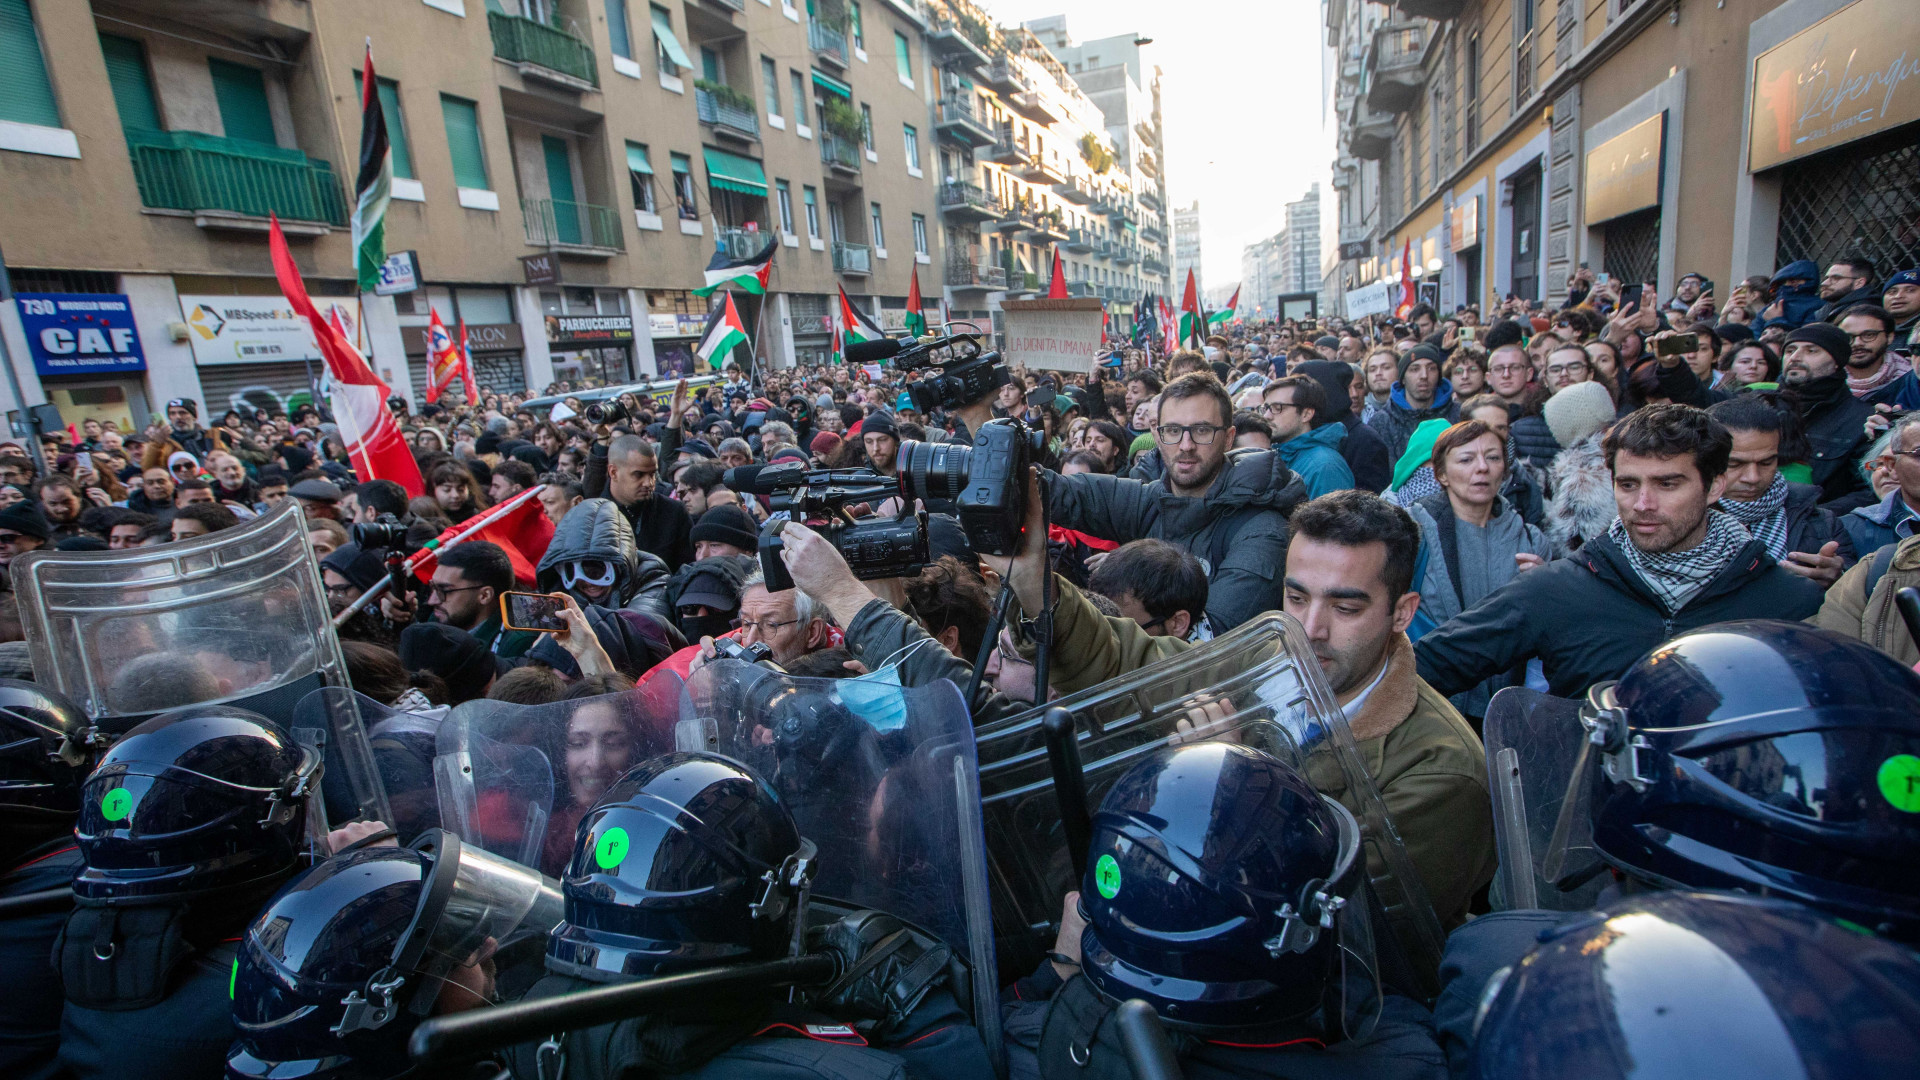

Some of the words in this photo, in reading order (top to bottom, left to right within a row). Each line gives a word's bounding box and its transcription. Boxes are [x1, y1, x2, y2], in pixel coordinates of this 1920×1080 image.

[558, 317, 632, 331] PARRUCCHIERE
[40, 328, 134, 354] CAF
[1010, 337, 1023, 352] LA
[1059, 340, 1093, 356] UMANA
